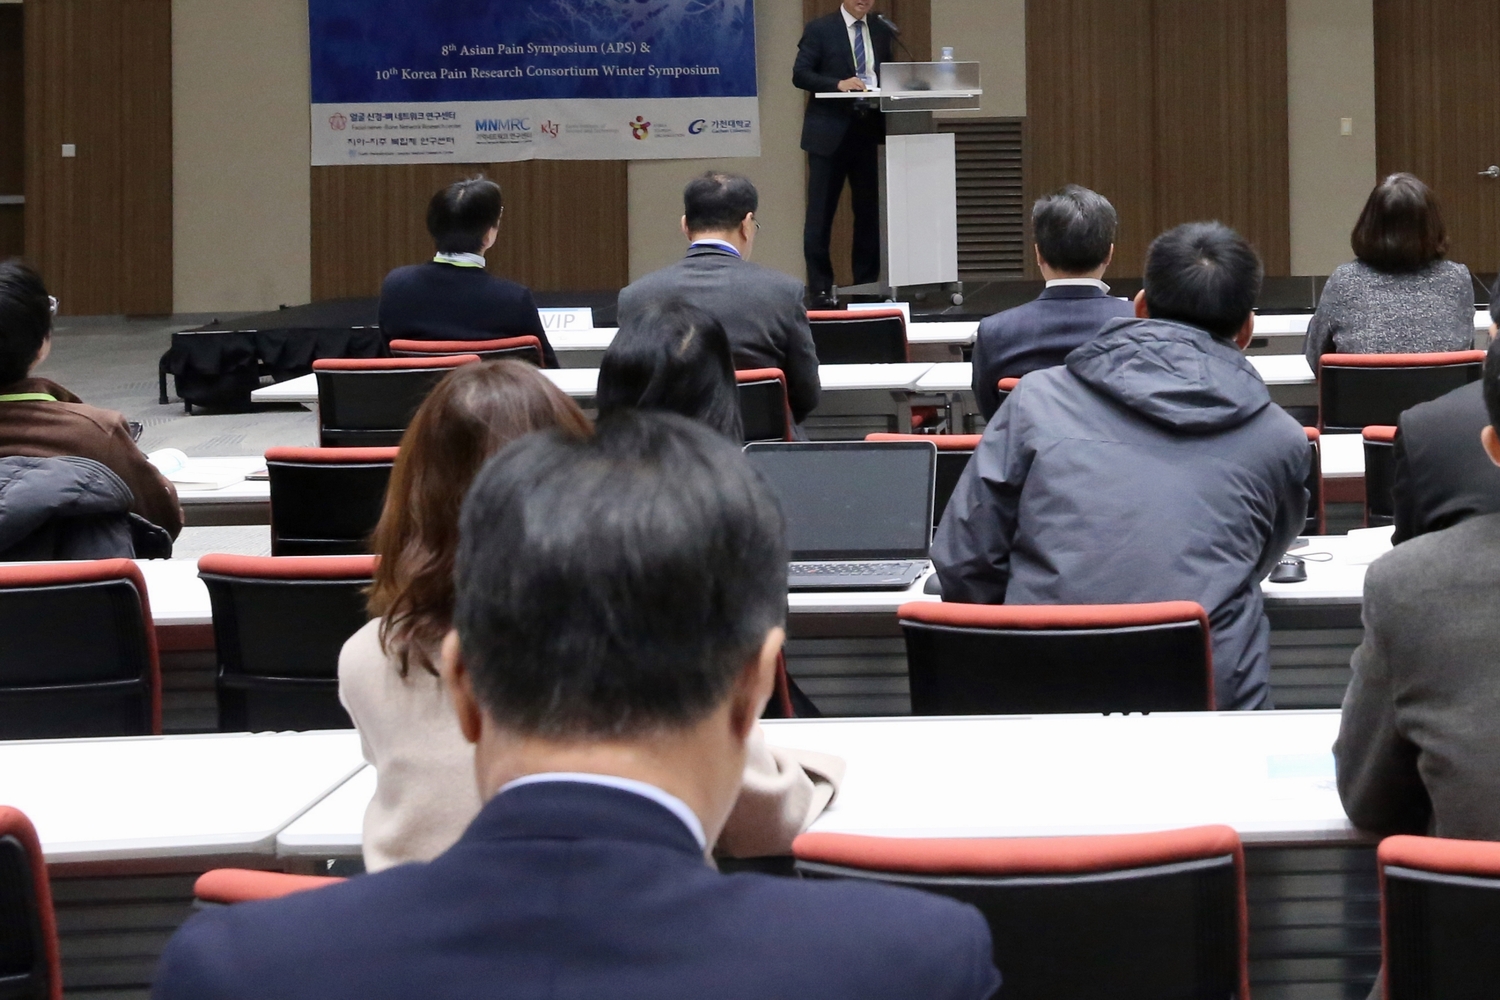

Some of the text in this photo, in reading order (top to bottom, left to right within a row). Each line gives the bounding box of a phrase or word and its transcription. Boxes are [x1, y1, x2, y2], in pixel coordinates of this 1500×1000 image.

[441, 42, 650, 56] 8th Asian Pain Symposium (APS) &
[375, 64, 720, 80] 10th Korea Pain Research Consortium Winter Symposium
[475, 117, 531, 131] MNMRC
[542, 313, 575, 328] VIP
